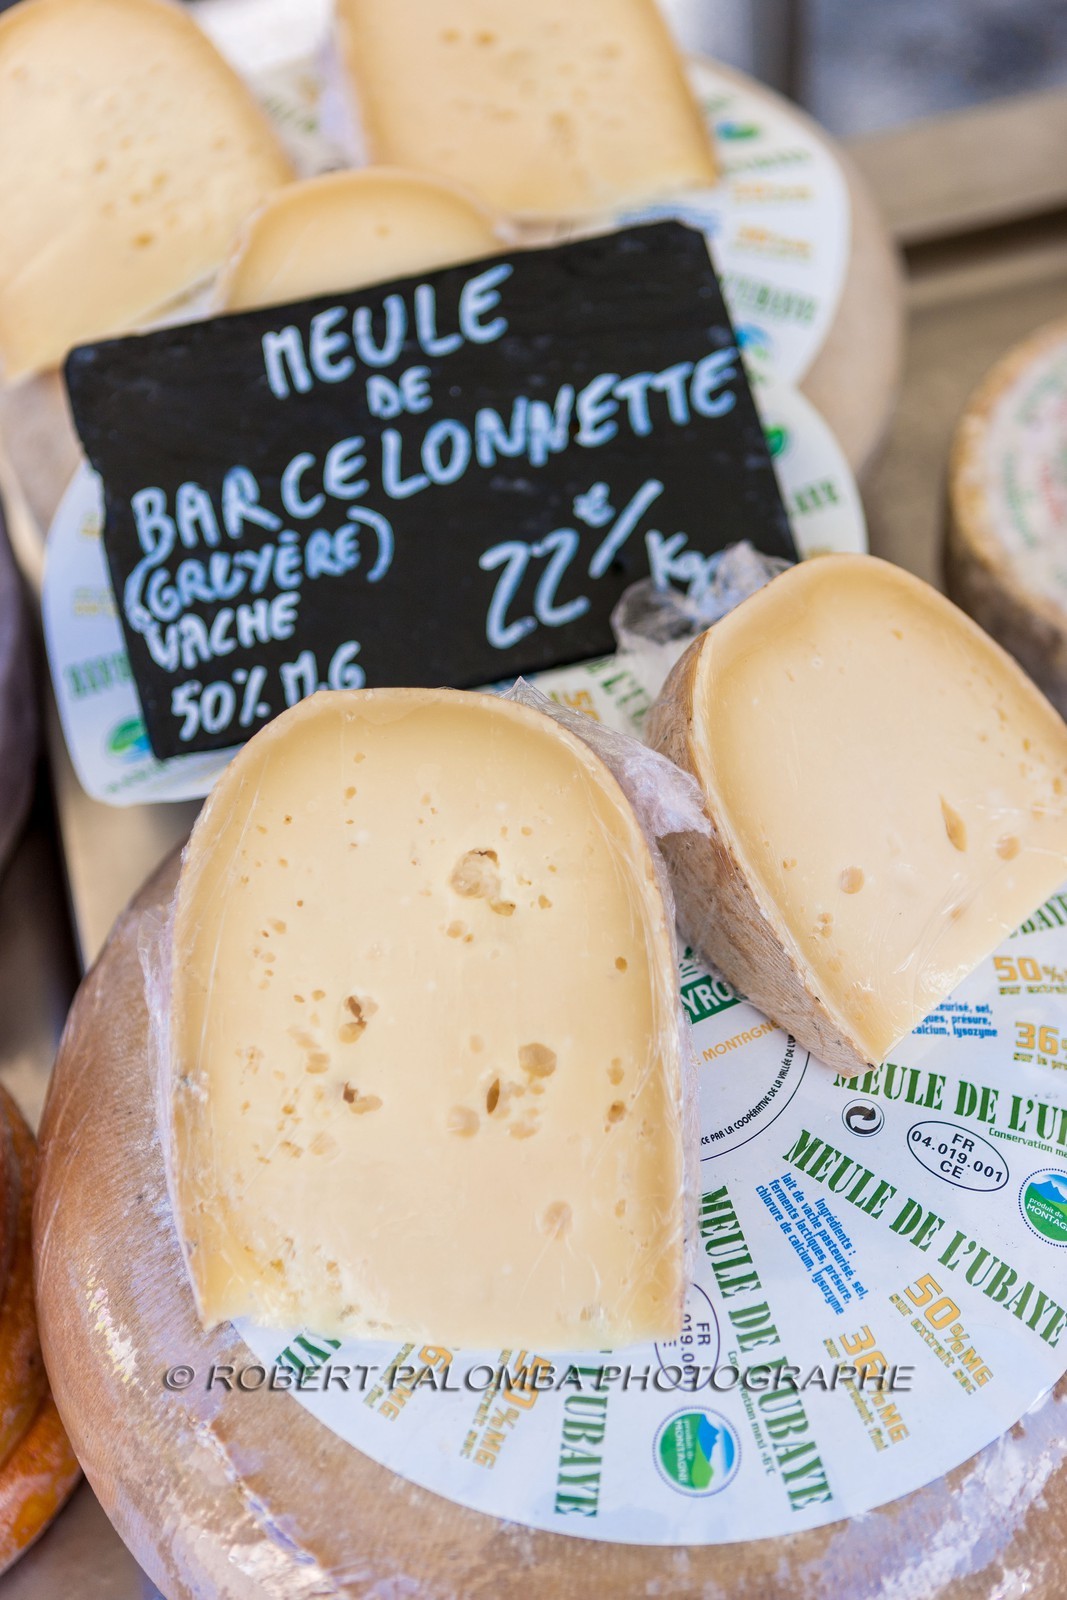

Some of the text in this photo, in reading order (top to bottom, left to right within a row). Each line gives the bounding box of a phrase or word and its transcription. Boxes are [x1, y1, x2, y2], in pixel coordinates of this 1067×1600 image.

[261, 263, 514, 398] MEULE
[366, 365, 433, 419] DE
[130, 346, 739, 562] BARCELONNETTE
[143, 591, 301, 673] VACHE
[171, 665, 272, 741] 50%
[993, 956, 1067, 983] 50%
[923, 1014, 948, 1024] ques,
[936, 1003, 972, 1013] eurisé,
[953, 1025, 998, 1038] lysozyme
[777, 1058, 792, 1080] VALLÉE
[785, 1048, 796, 1058] DE
[767, 1086, 778, 1098] DE
[774, 1079, 784, 1089] LA
[733, 1095, 772, 1130] COOPÉRATIVE
[953, 1080, 1000, 1125] DE
[711, 1131, 726, 1142] PAR
[725, 1125, 735, 1136] LA
[951, 1133, 975, 1152] FR
[988, 1127, 1053, 1154] Conservation
[911, 1130, 1003, 1183] 04.019.001
[939, 1160, 964, 1179] CE
[814, 1198, 853, 1251] Ingrédients
[1026, 1203, 1067, 1232] MONTAG
[1029, 1198, 1064, 1219] produit de
[698, 1185, 762, 1299] MEULE
[755, 1185, 845, 1316] chlorure de calcium, lysozyme
[768, 1179, 852, 1304] ferments lactiques, présure,
[781, 1172, 869, 1301] lait de vache pasteurisé, sel,
[782, 1129, 1067, 1349] MEULE DE L'UBAYE
[697, 1322, 711, 1346] FR
[728, 1301, 780, 1353] DE
[889, 1293, 913, 1317] sur
[910, 1318, 955, 1368] extrait
